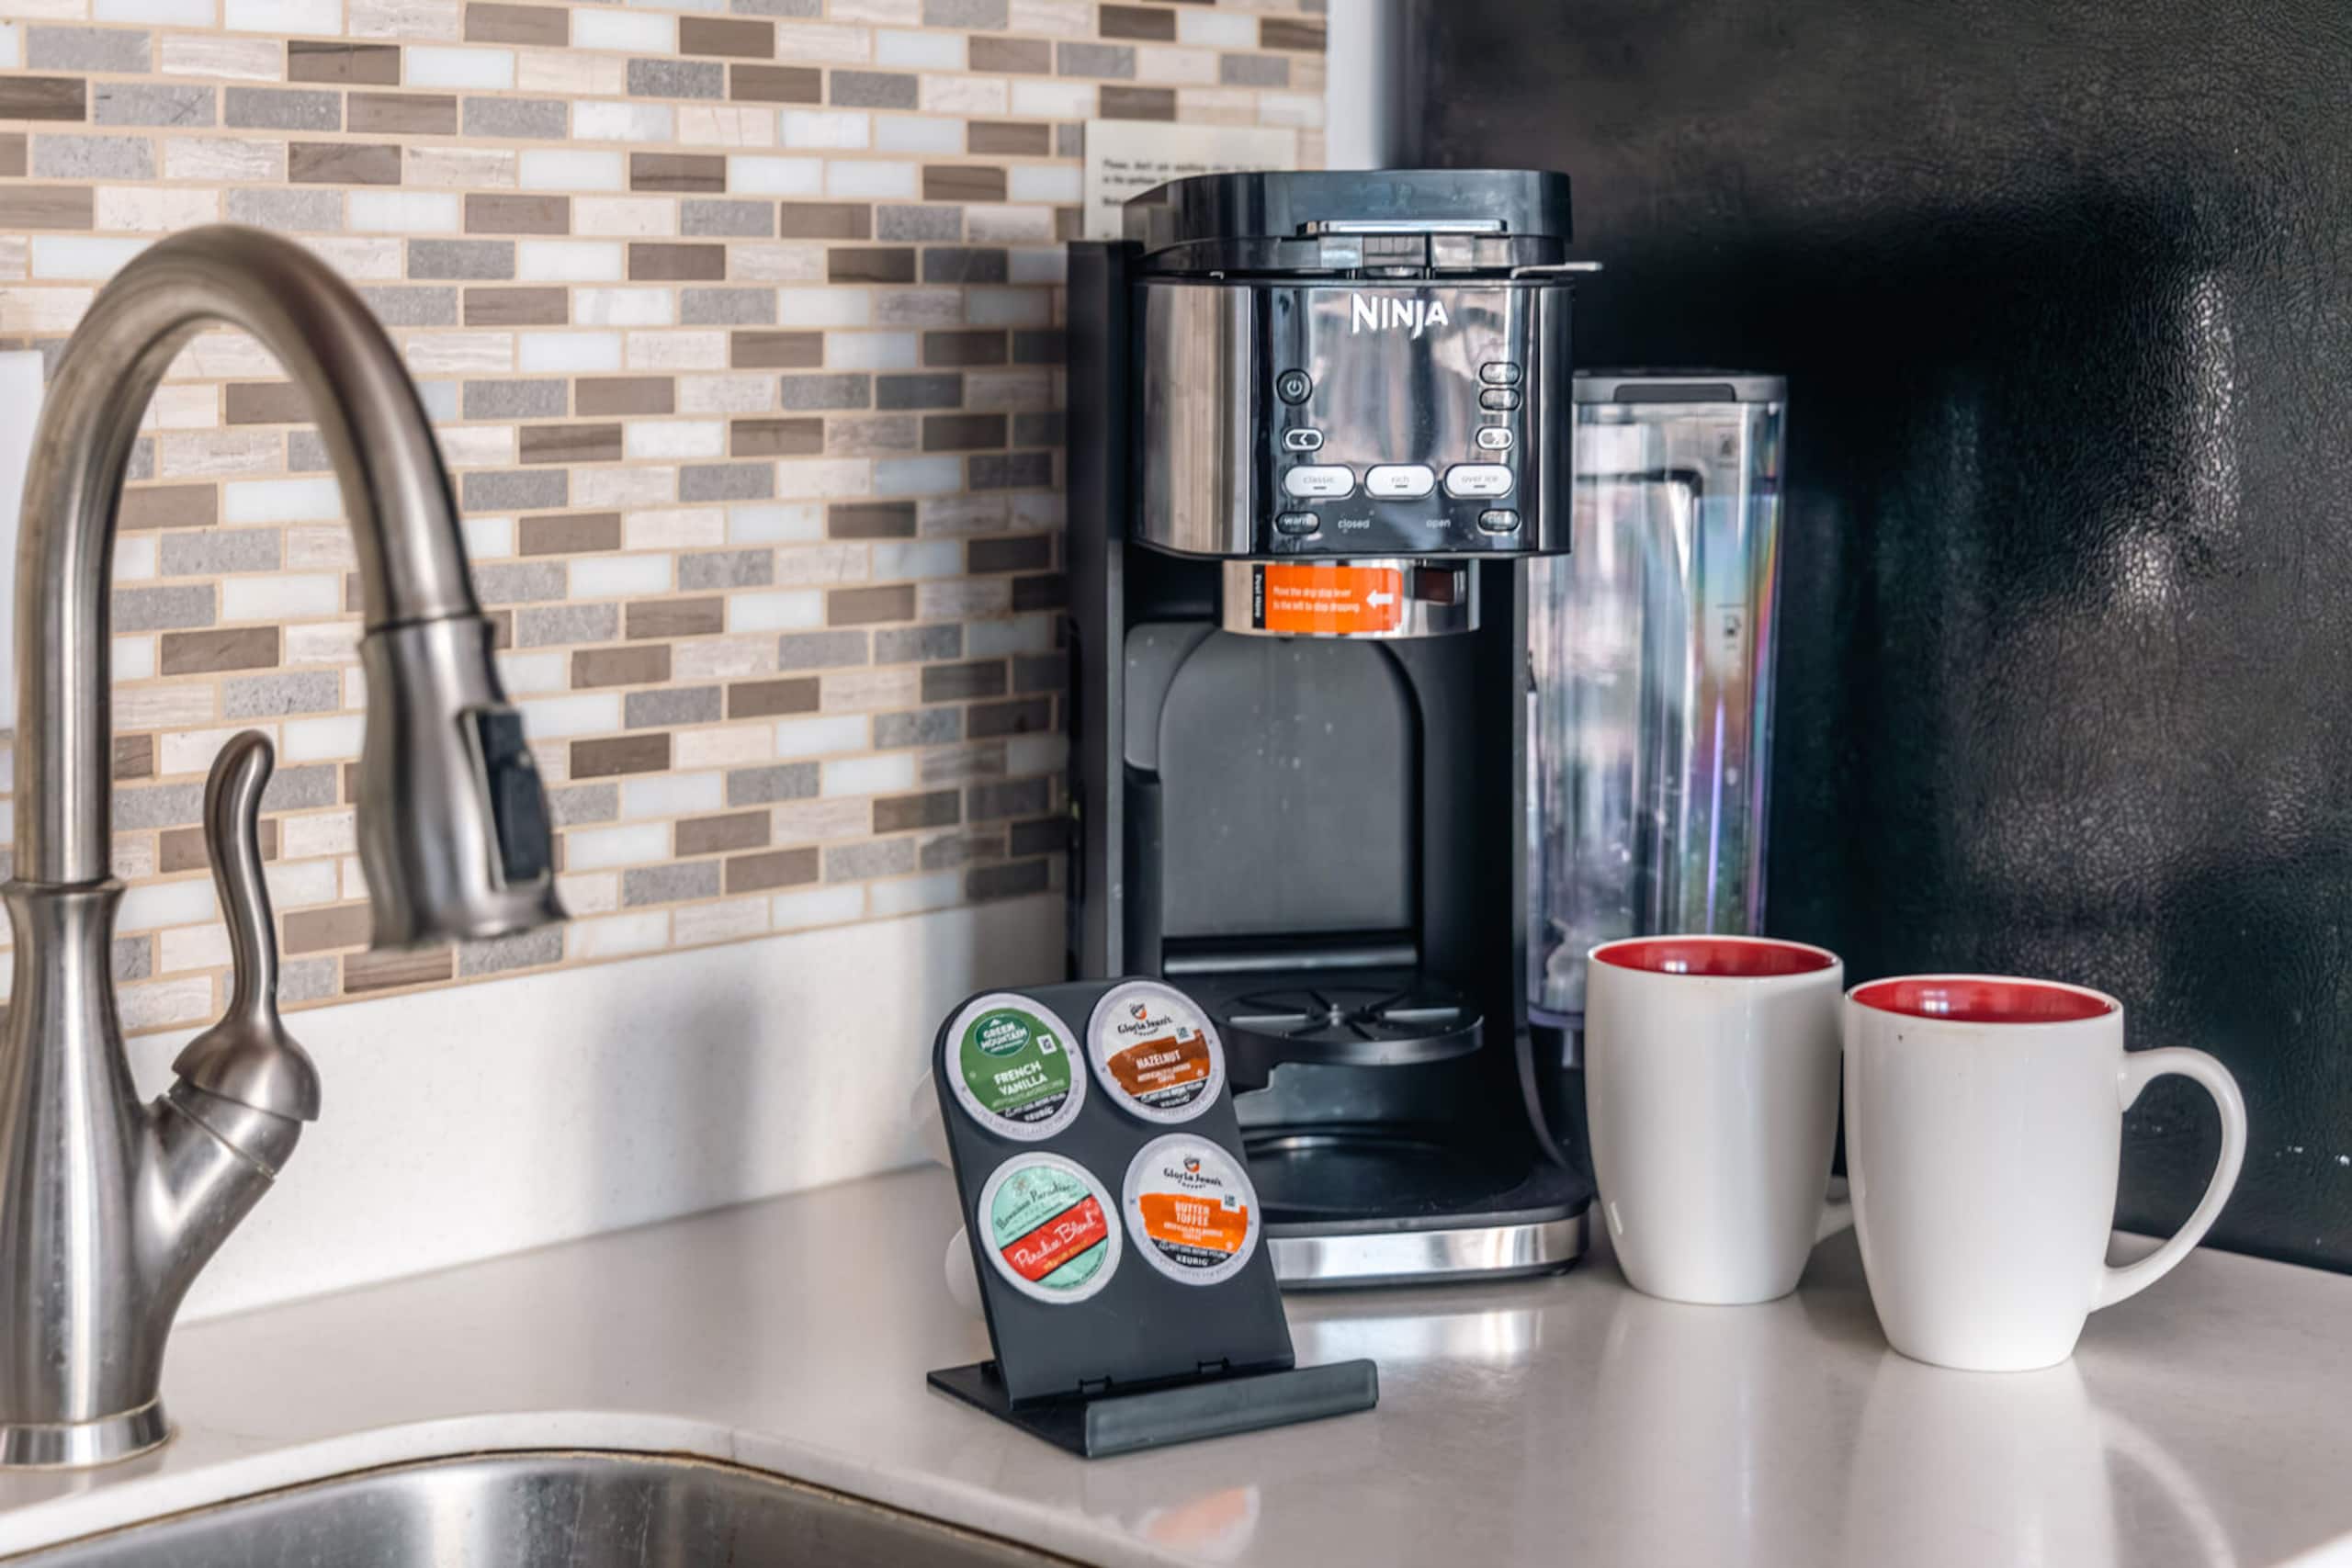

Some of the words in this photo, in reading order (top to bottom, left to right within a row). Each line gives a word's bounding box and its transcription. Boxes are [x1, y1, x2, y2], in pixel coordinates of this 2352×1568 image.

[1351, 293, 1449, 339] NINJA
[1303, 474, 1335, 485] classic
[1391, 474, 1410, 485] rich
[1461, 475, 1480, 485] over
[1483, 473, 1498, 484] ice
[1338, 517, 1371, 529] closed
[1426, 518, 1452, 530] open
[983, 1021, 1015, 1039] GREEN
[1117, 1019, 1147, 1034] Gloria
[980, 1028, 1027, 1049] MOUNTAIN
[1136, 1049, 1182, 1069] HAZELNUT
[994, 1061, 1042, 1085] FRENCH
[999, 1073, 1048, 1095] VANILLA
[1163, 1167, 1194, 1185] Gloria
[1175, 1201, 1211, 1215] BUTTER
[1175, 1212, 1210, 1227] TOFFEE
[1013, 1238, 1062, 1269] Paradise
[1054, 1212, 1097, 1244] Blend
[1176, 1253, 1209, 1267] KEURIG
